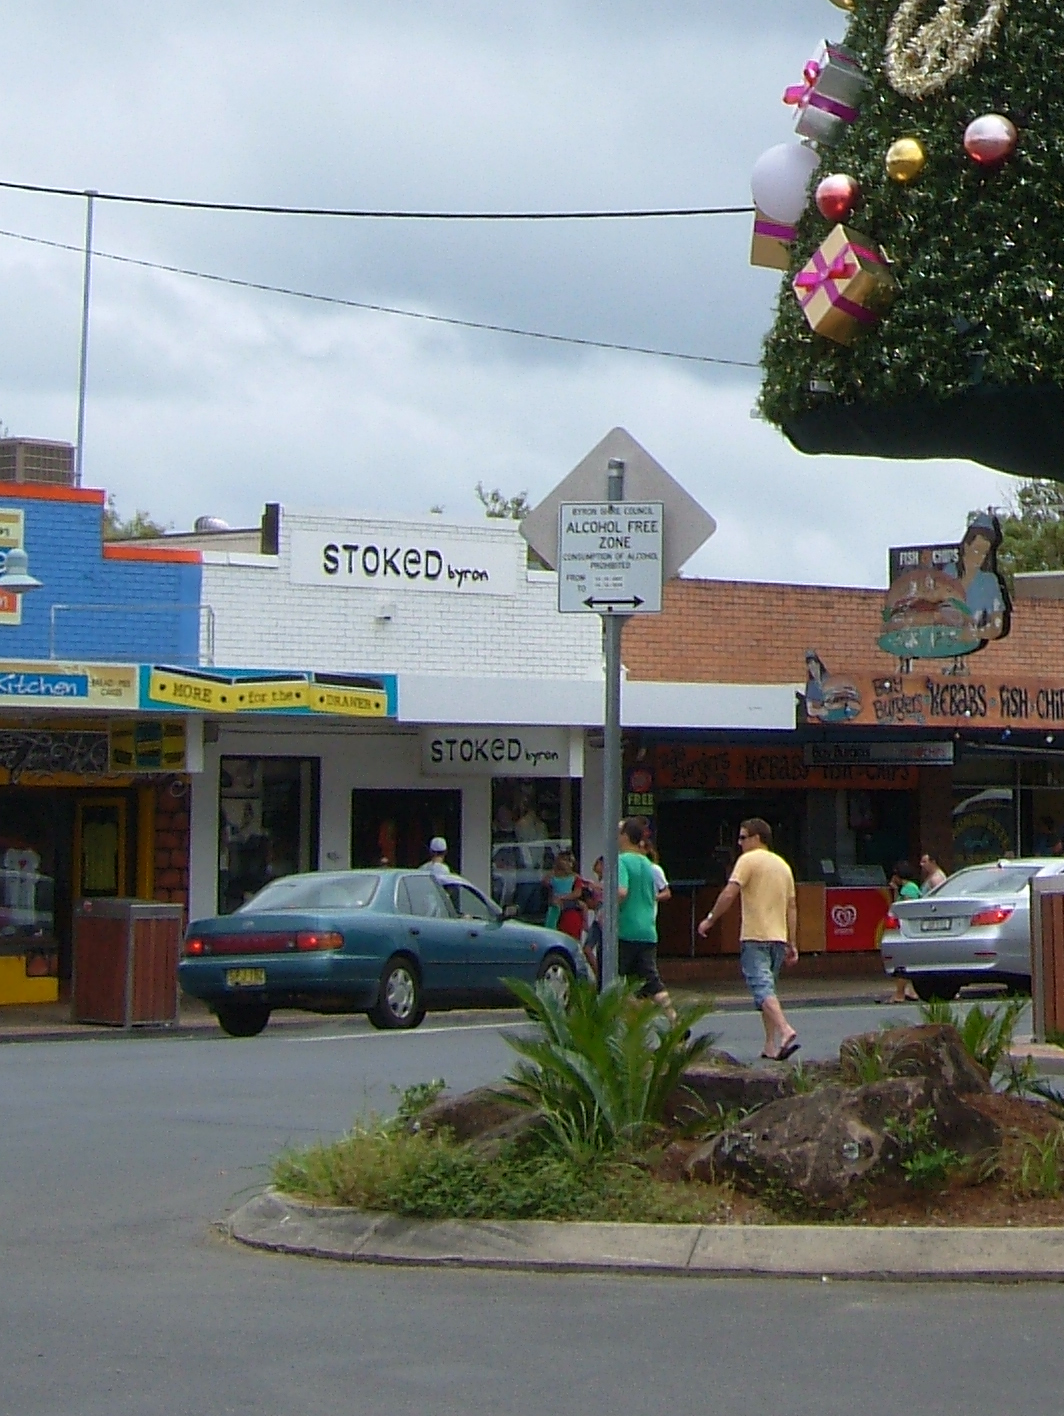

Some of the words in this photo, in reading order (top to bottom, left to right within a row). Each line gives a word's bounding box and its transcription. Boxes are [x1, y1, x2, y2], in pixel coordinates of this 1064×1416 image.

[624, 507, 654, 515] COUNCIL
[566, 521, 622, 533] ALCOHOL
[628, 520, 659, 533] FREE
[599, 536, 631, 549] ZONE
[563, 553, 612, 561] CONSUMPTION
[615, 552, 624, 560] OF
[628, 552, 658, 561] ALCOHOL
[900, 551, 919, 566] FISH
[590, 562, 631, 570] PROHIBITED
[448, 564, 489, 587] byron
[566, 574, 586, 582] FROM
[577, 584, 586, 593] TO
[172, 682, 212, 703] MORE
[247, 690, 266, 704] for
[271, 688, 293, 702] the
[326, 693, 372, 710] DRAWER
[525, 748, 559, 766] byron
[628, 793, 654, 805] FREE
